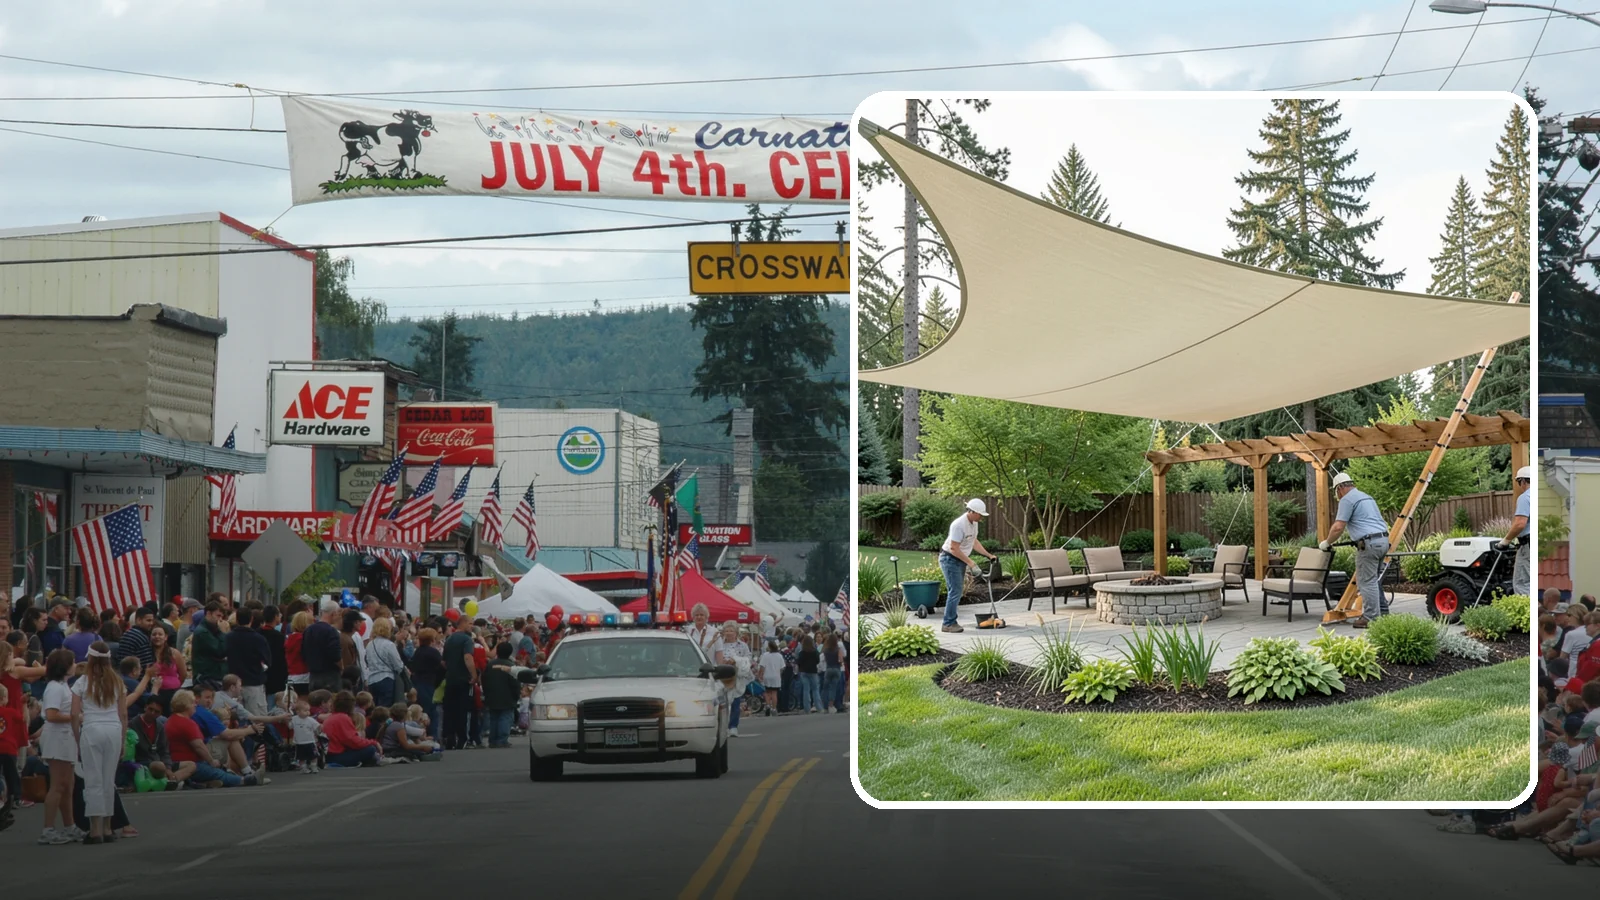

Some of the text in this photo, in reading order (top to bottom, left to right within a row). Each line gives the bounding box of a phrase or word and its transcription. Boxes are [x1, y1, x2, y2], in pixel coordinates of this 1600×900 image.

[481, 141, 604, 192] JULY
[632, 150, 746, 198] 4th.
[697, 254, 850, 281] CROSSWA
[283, 380, 373, 420] ACE
[406, 409, 452, 422] CEDAR
[283, 421, 371, 436] Hardware
[353, 466, 384, 481] Simpl
[95, 485, 124, 495] Vincent
[126, 486, 136, 495] de
[137, 486, 155, 495] Paul
[81, 503, 154, 522] THT
[688, 526, 741, 535] CRNATION
[699, 535, 730, 543] GLASS
